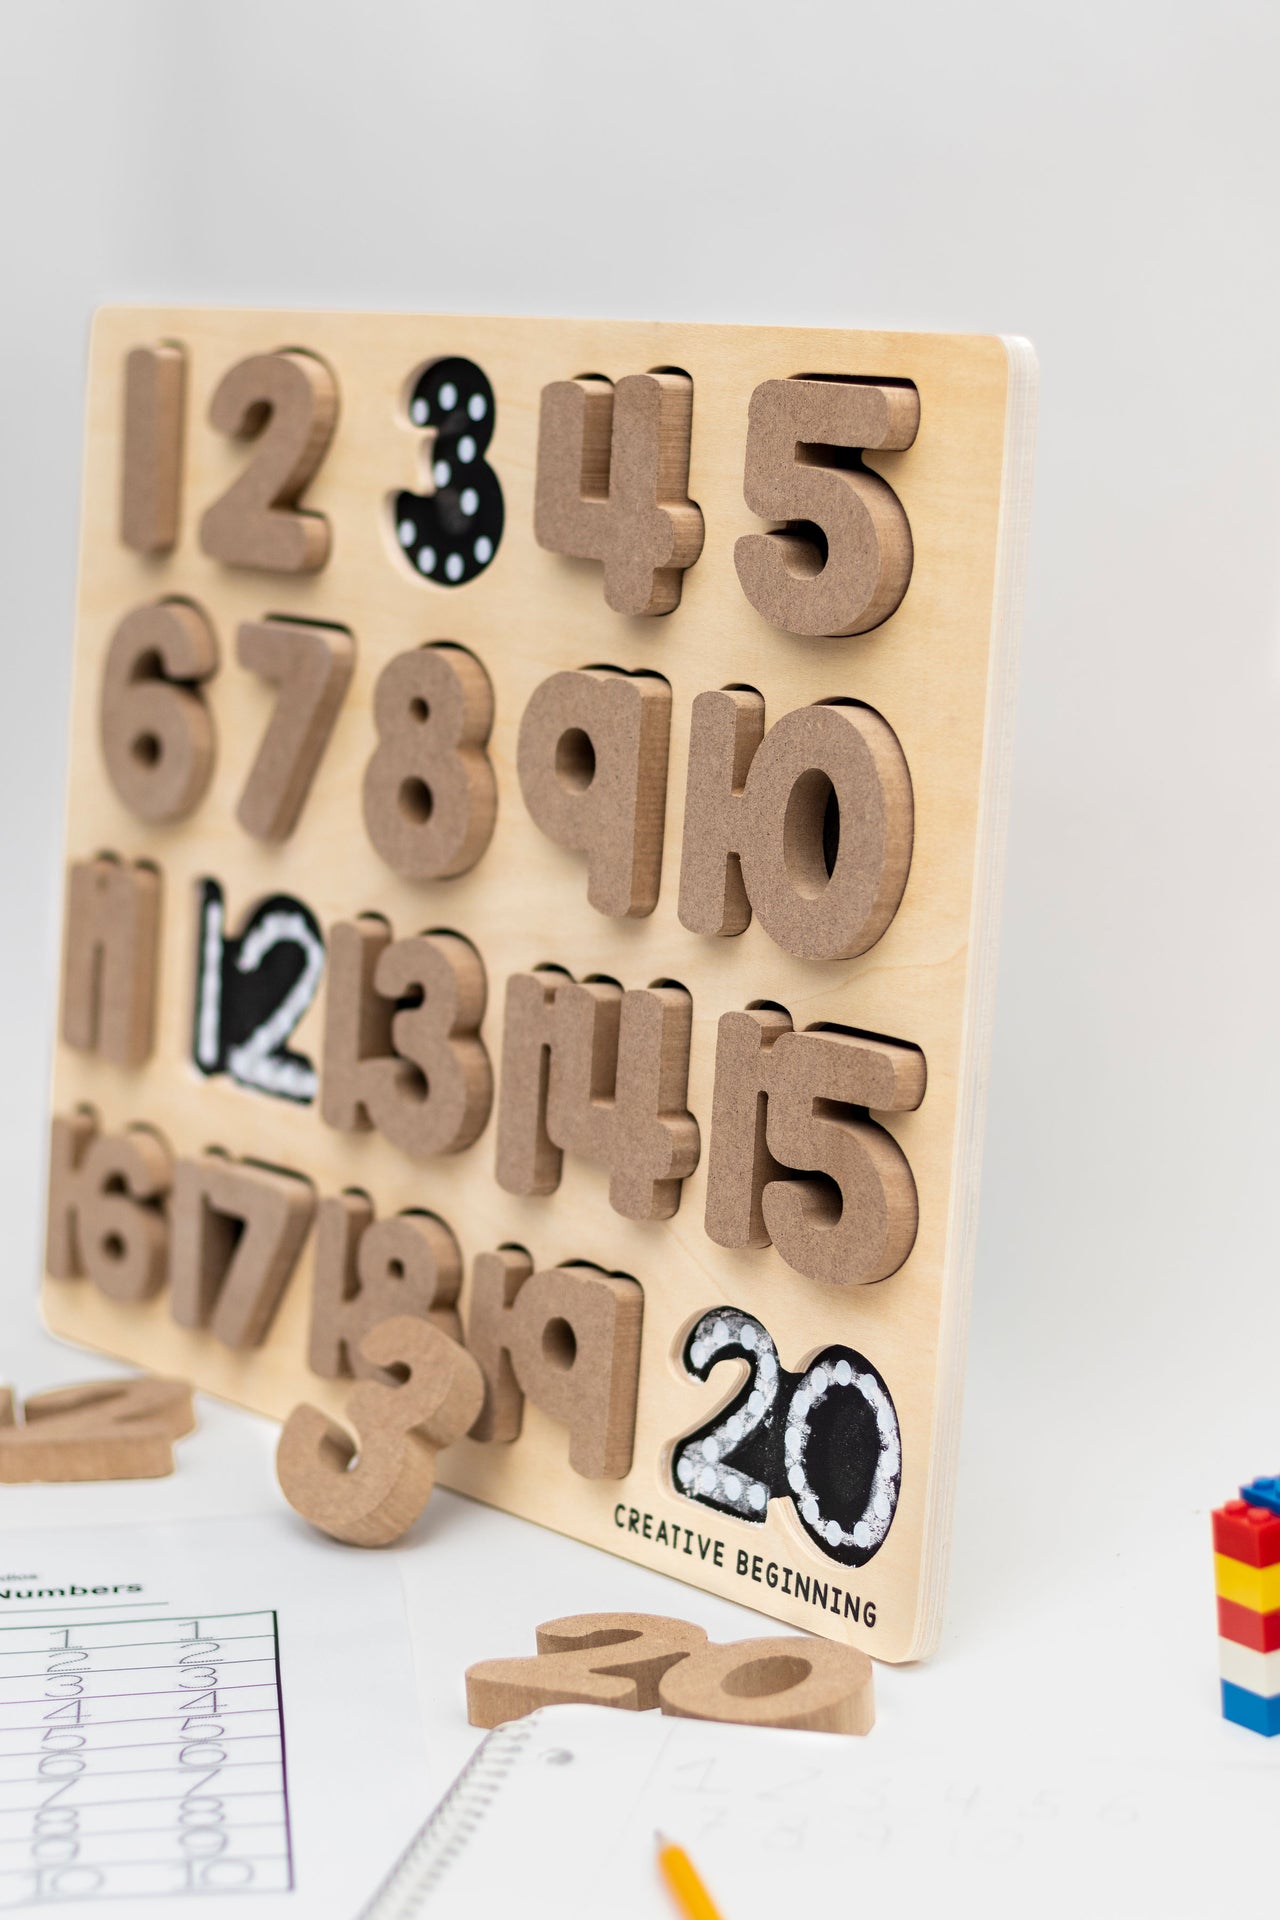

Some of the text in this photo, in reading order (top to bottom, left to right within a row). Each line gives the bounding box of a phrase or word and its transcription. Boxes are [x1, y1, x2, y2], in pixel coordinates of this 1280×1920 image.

[121, 340, 921, 638] 1 2 3 4 5
[100, 596, 915, 961] 6 7 8 9 10
[63, 851, 927, 1286] 11 12 13 14 15
[46, 1103, 901, 1568] 16 17 18 19 20
[276, 1315, 485, 1547] 3
[0, 1584, 143, 1599] Numbers
[614, 1503, 877, 1628] CREATIVE BEGINNING
[47, 1642, 224, 1672] 2 2
[49, 1621, 213, 1649] 1 1
[465, 1612, 876, 1736] 20
[43, 1691, 227, 1723] 4 4
[45, 1666, 218, 1697] 3 3
[41, 1716, 225, 1751] 5 5
[179, 1742, 227, 1767] 6
